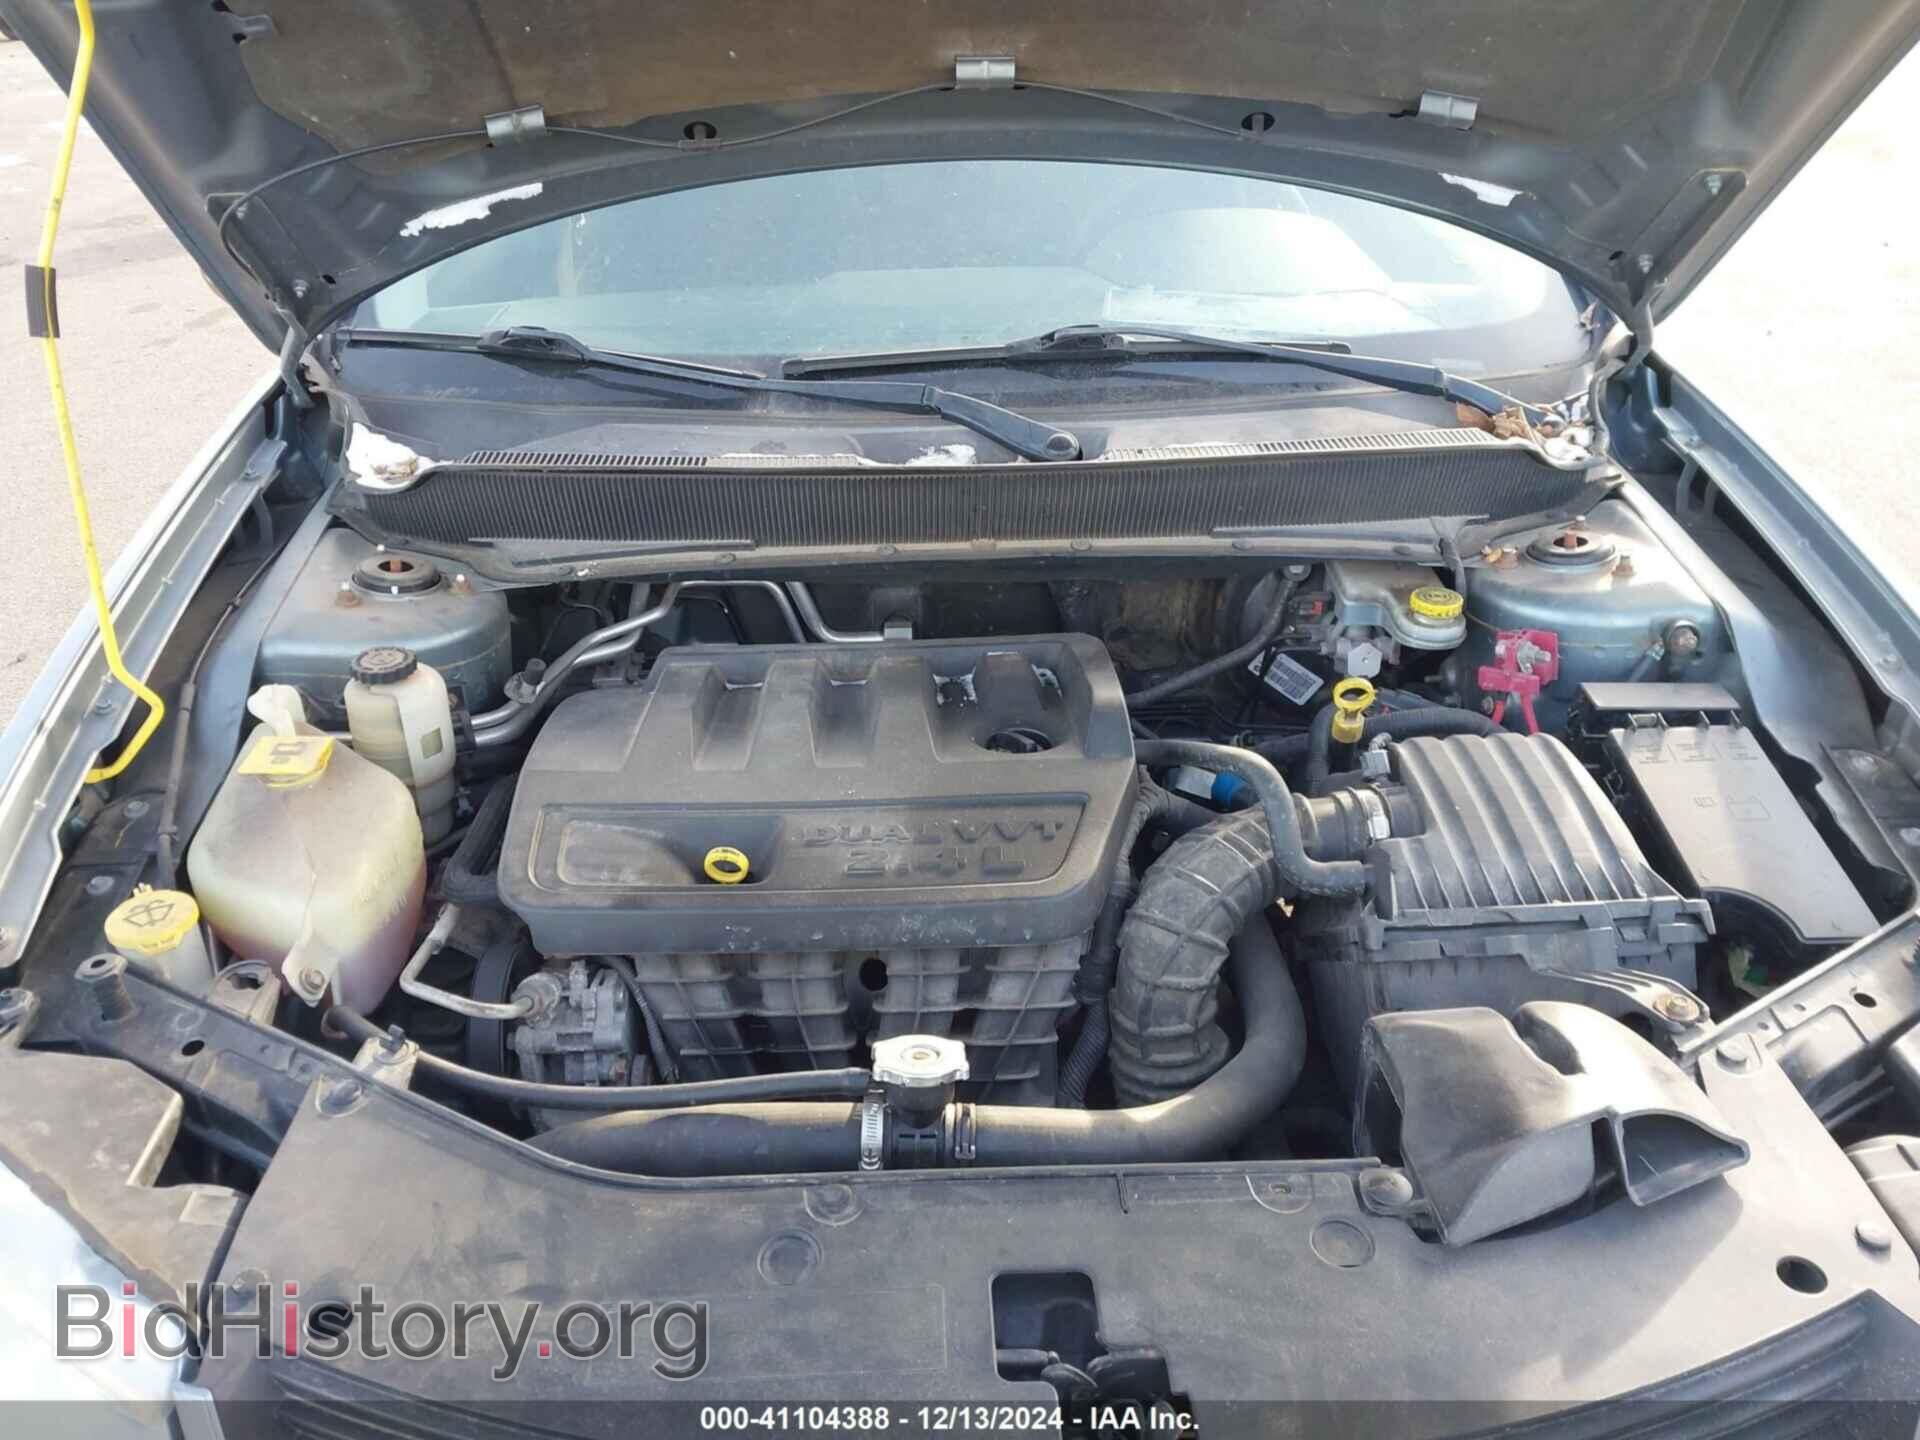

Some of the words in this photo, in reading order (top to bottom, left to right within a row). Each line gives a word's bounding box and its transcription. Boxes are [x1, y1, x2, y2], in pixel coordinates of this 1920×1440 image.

[803, 821, 943, 848] DUAL
[953, 819, 1065, 842] VVT
[846, 847, 1026, 877] 2.4L
